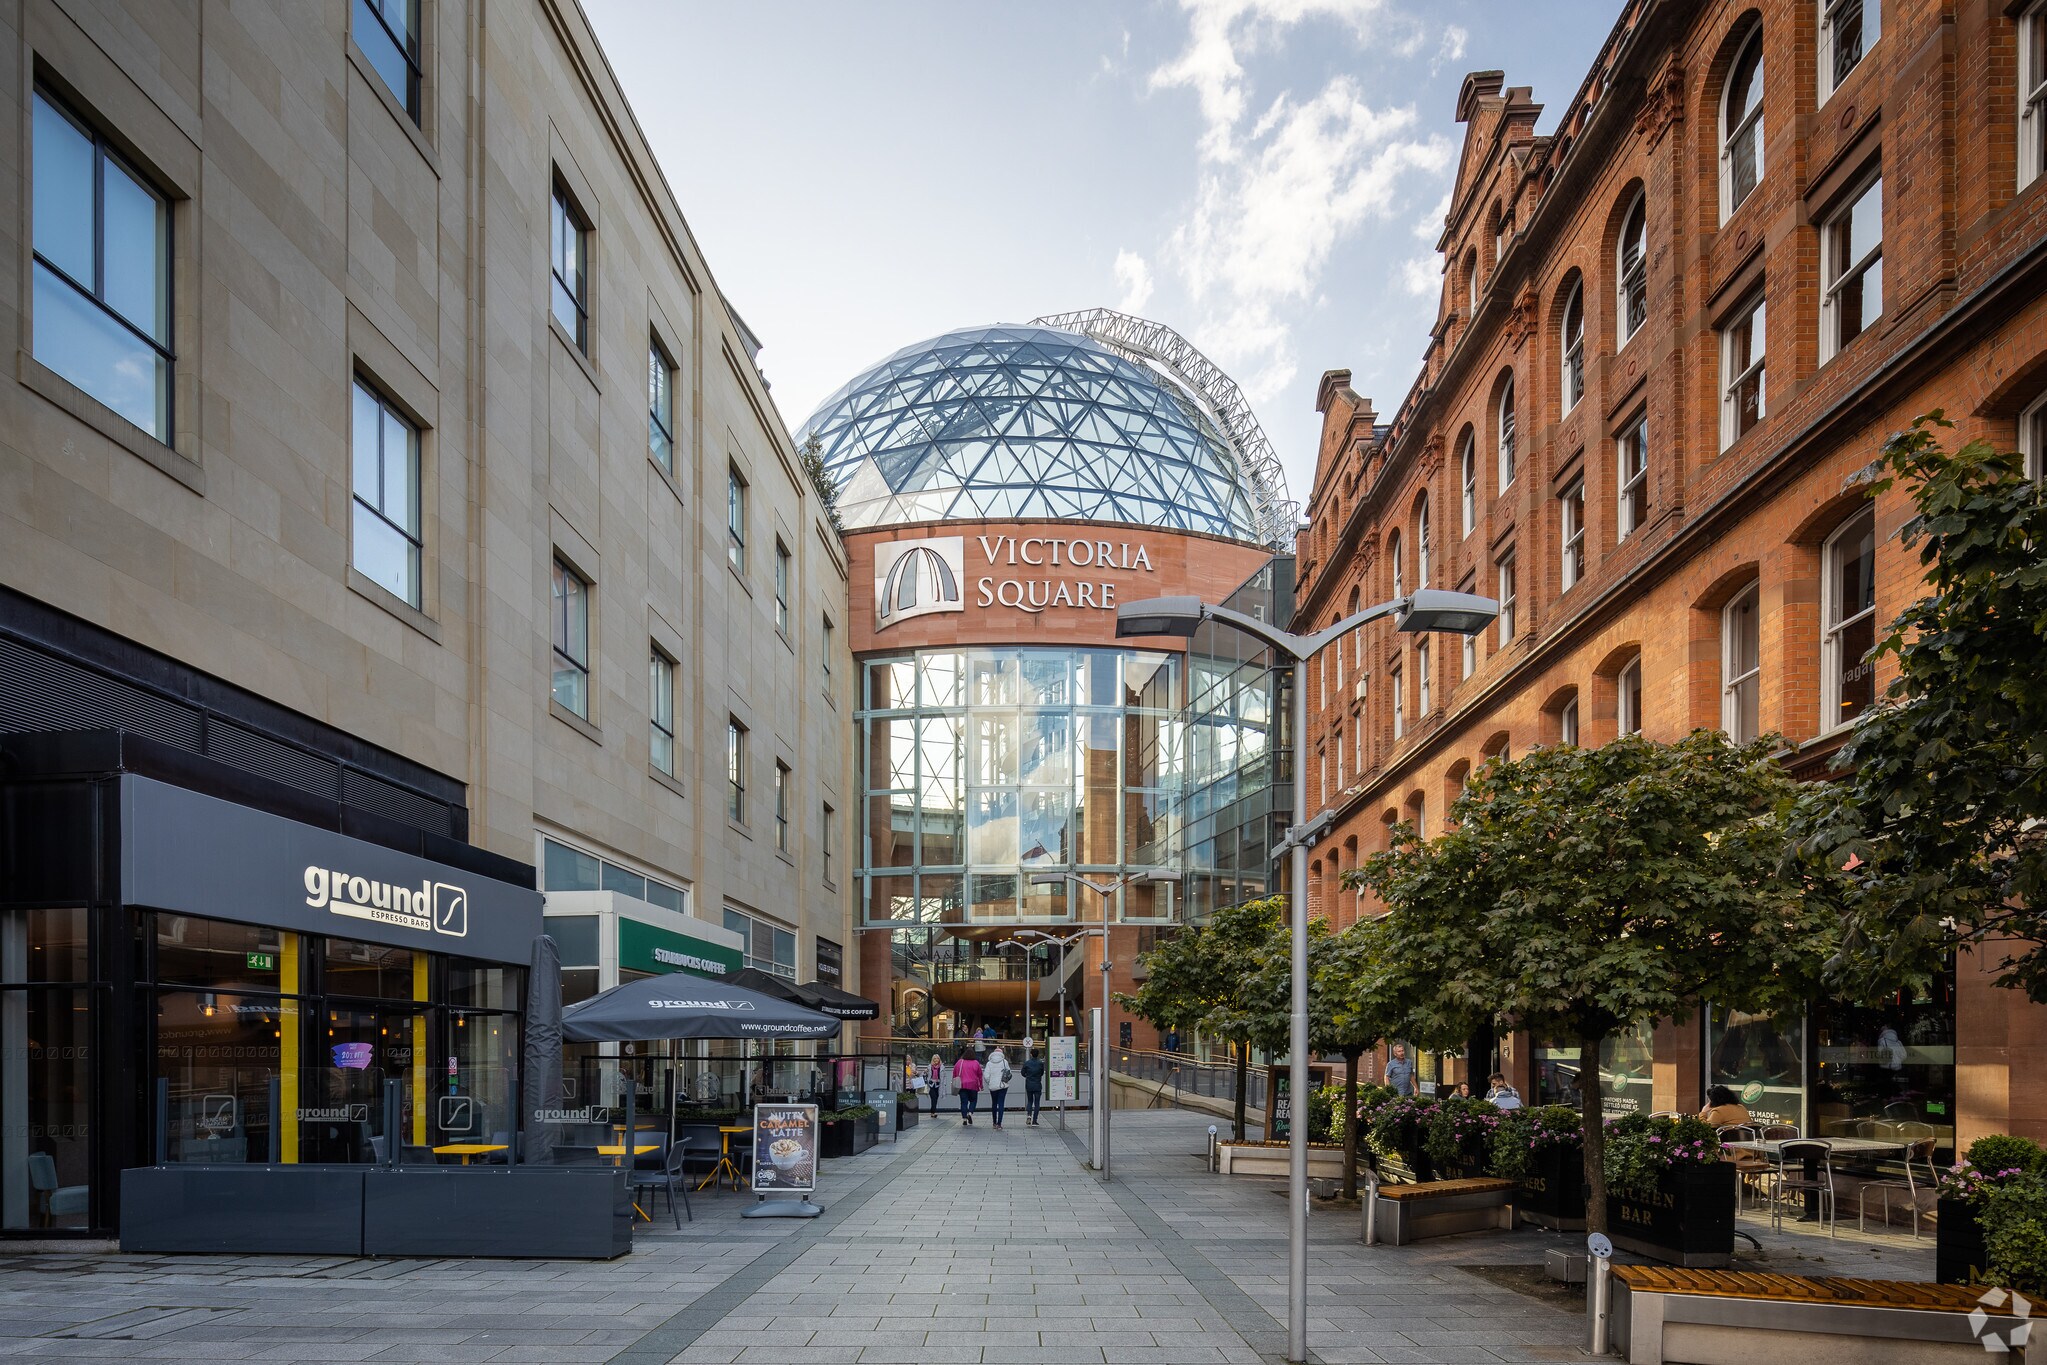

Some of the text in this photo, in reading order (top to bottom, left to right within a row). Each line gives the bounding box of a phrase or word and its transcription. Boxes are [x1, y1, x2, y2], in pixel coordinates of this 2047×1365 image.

[977, 535, 1154, 571] VICTORIA
[977, 577, 1116, 612] SQUARE
[304, 865, 431, 918] ground
[371, 910, 429, 929] ESPRESSO BARS
[654, 948, 727, 975] STARBUCKS COFFEE
[648, 1000, 729, 1009] ground
[741, 1023, 827, 1033] www.groundcoffee.net
[296, 1104, 349, 1121] ground
[534, 1105, 590, 1122] ground
[770, 1111, 804, 1120] NUTTY
[1756, 1111, 1774, 1119] MADE
[760, 1120, 810, 1129] CARAMEL
[772, 1128, 803, 1137] LATTE
[1621, 1205, 1653, 1226] BAR
